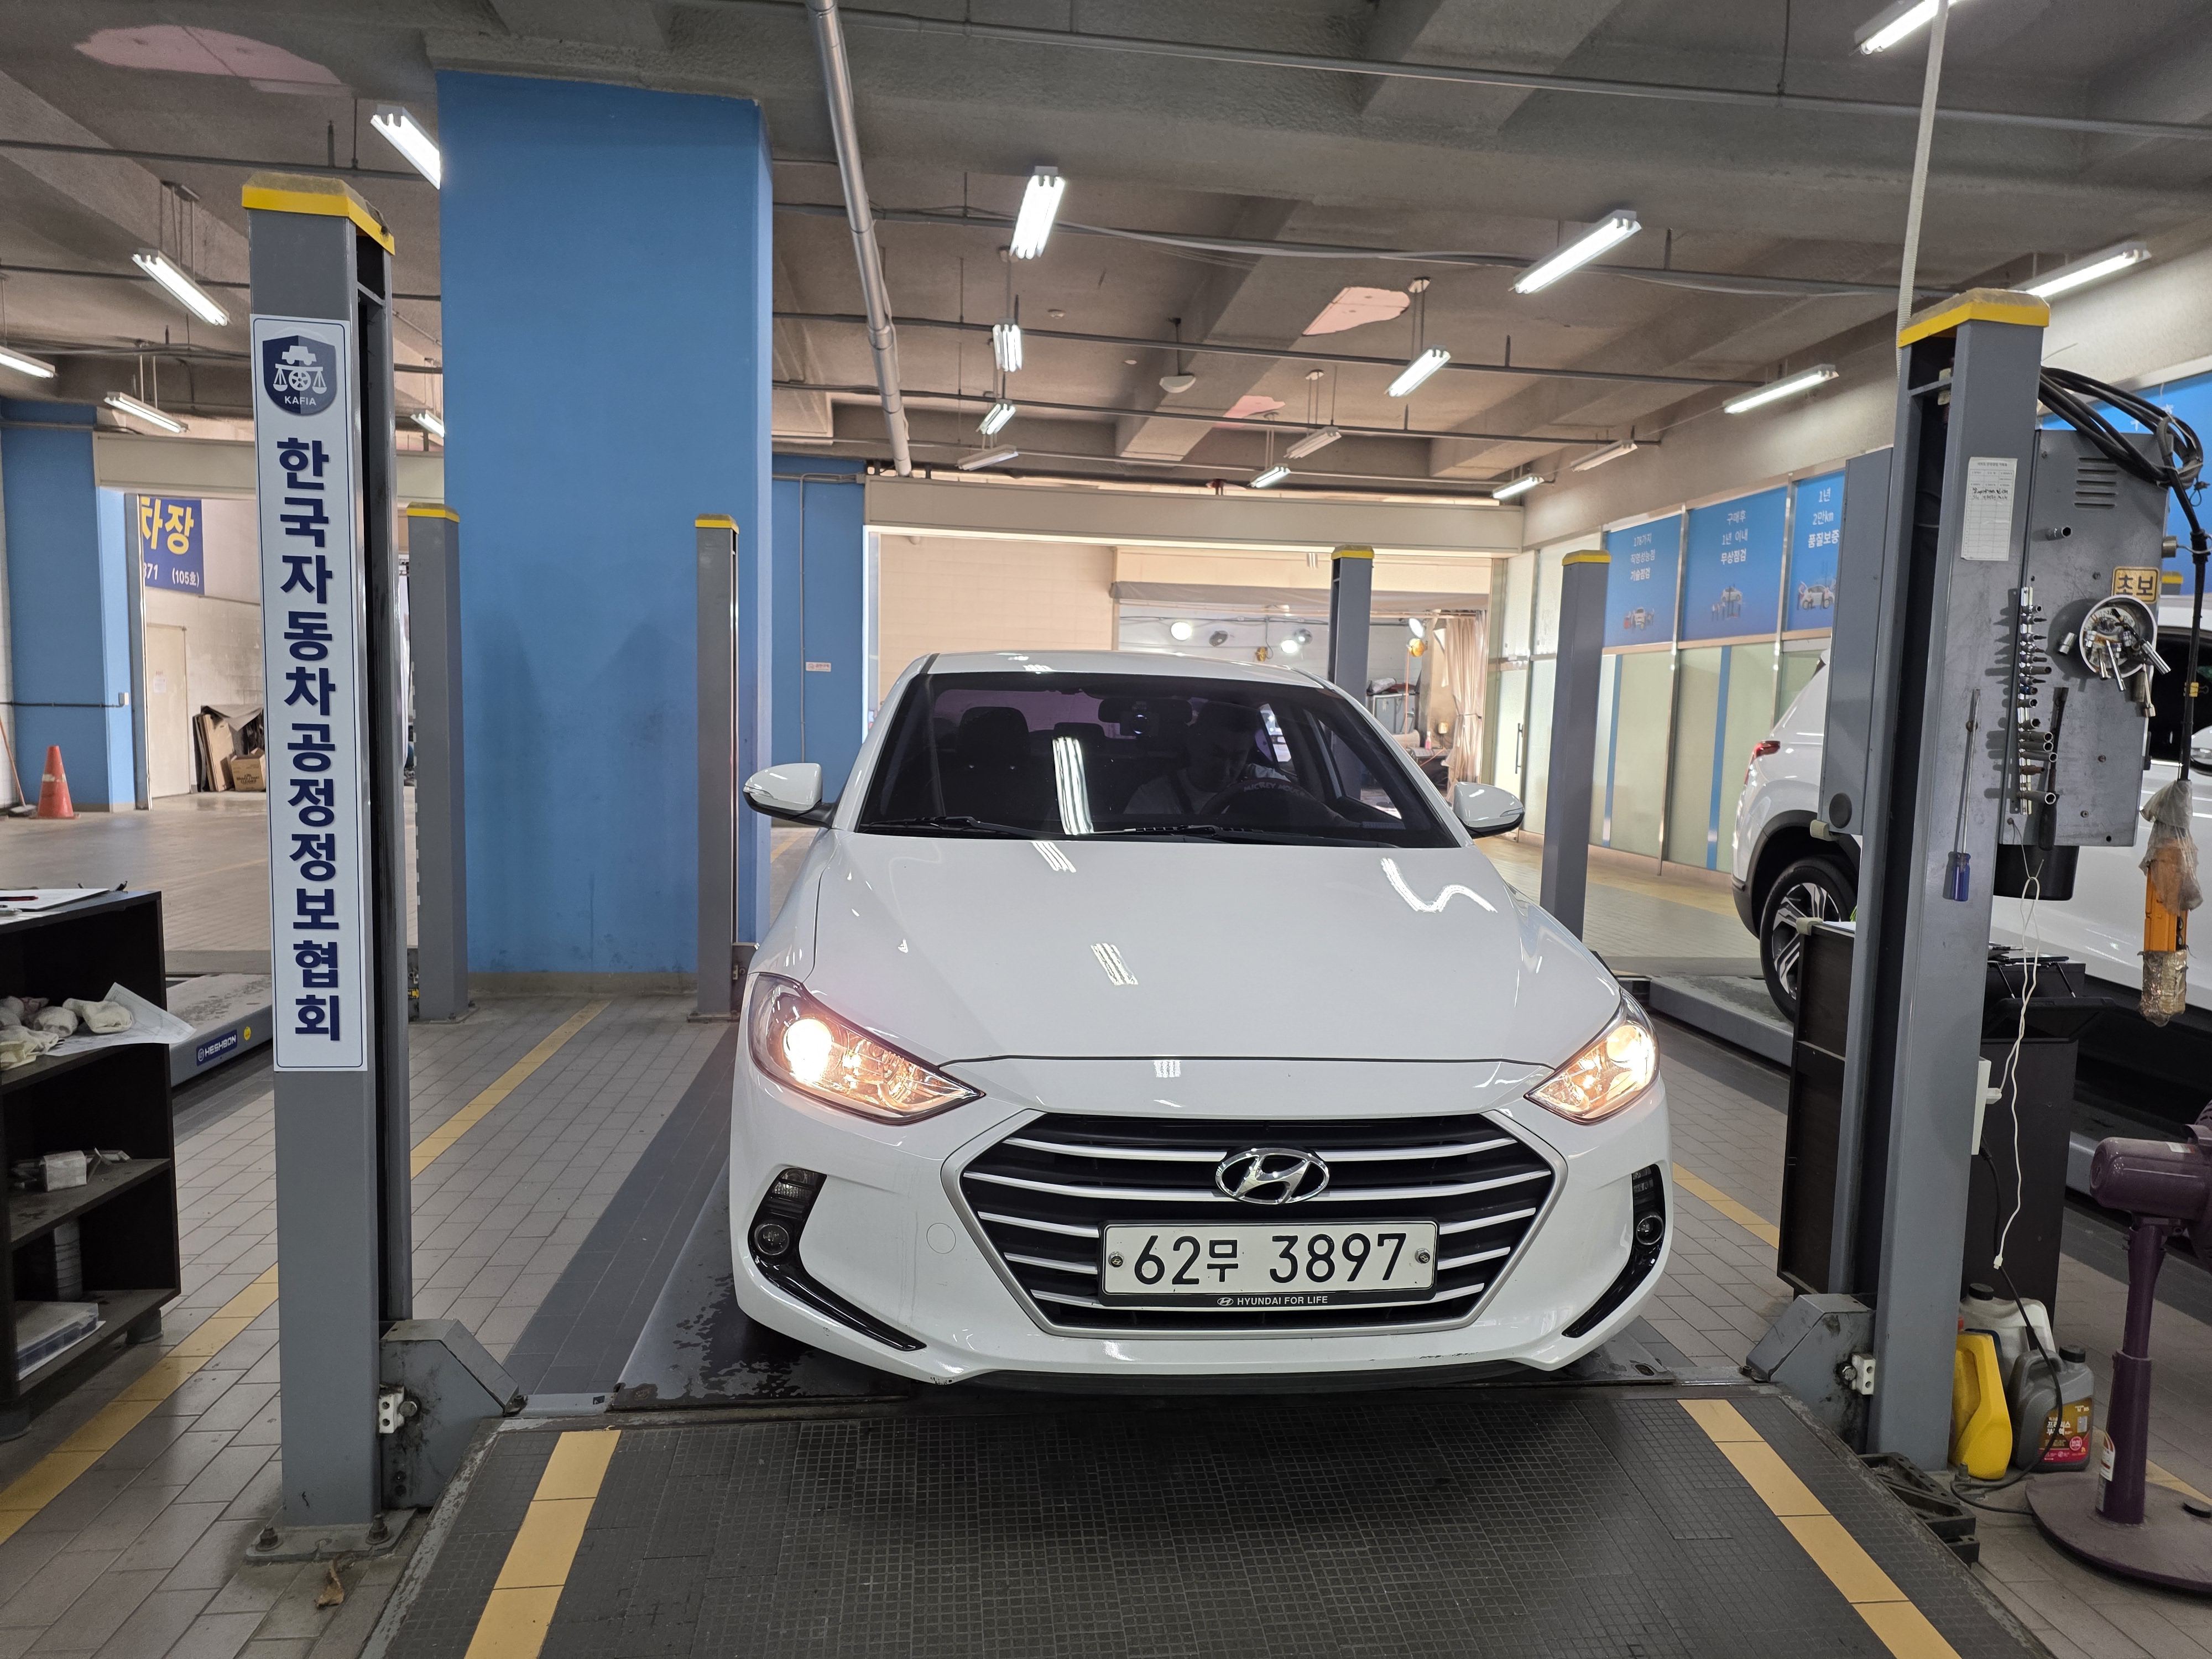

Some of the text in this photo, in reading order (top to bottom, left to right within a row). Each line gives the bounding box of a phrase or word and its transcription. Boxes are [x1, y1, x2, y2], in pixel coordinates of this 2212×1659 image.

[284, 395, 317, 406] KAFIA
[1819, 487, 1831, 503] 1년
[1813, 510, 1834, 525] 2만km
[1722, 528, 1748, 545] 1년 이내
[1808, 529, 1839, 549] 품질보증
[1720, 548, 1746, 565] 무상점검
[172, 567, 200, 588] (105호)
[2115, 575, 2153, 596] 초보
[276, 437, 340, 1041] 한국자동차공정정보협회
[205, 1035, 237, 1057] HESHBON
[1134, 1233, 1407, 1285] 62무 3897
[1237, 1296, 1328, 1306] HYUNDAI FOR LIFE
